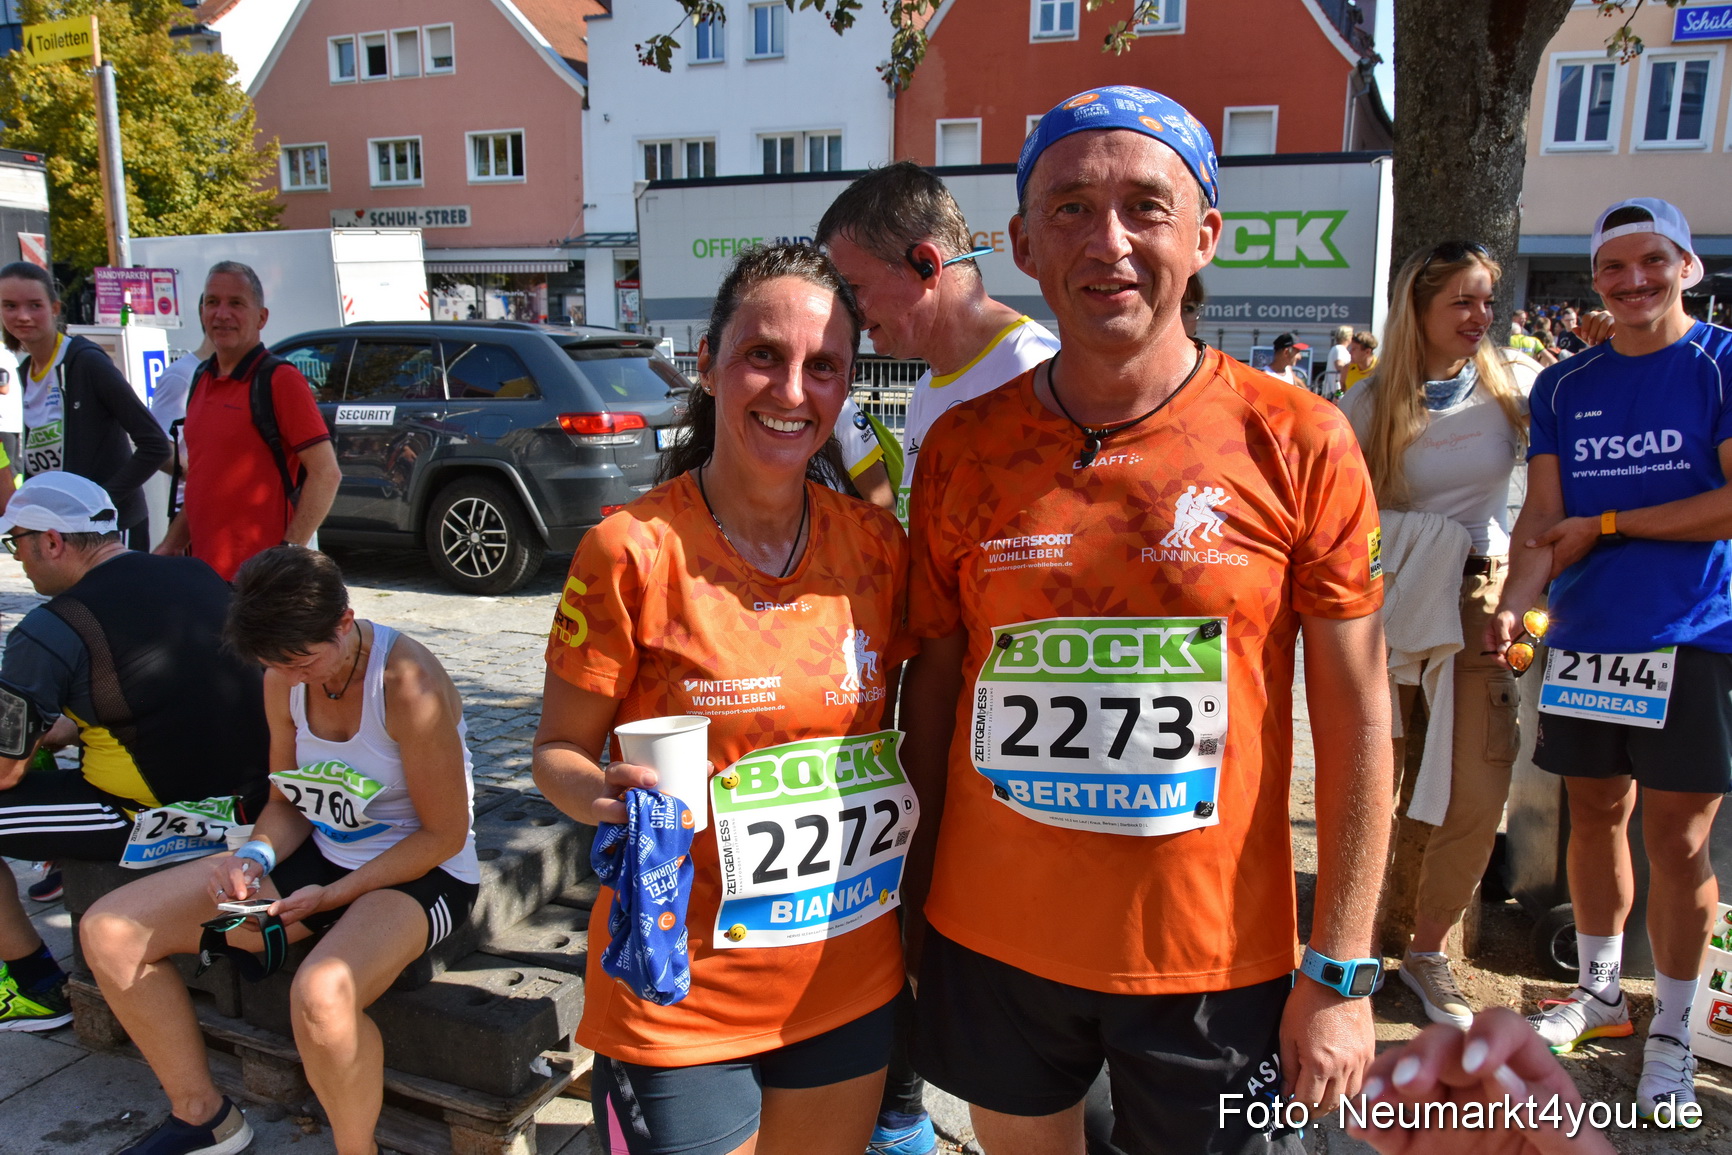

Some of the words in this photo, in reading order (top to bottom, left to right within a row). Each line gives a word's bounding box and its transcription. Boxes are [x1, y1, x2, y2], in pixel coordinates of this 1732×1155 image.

[36, 31, 89, 52] Toiletten
[370, 208, 467, 227] SCHUH-STREB
[97, 271, 149, 280] HANDYPARKEN
[1257, 303, 1349, 321] concepts
[339, 410, 391, 420] SECURITY
[1574, 429, 1682, 462] SYSCAD
[993, 533, 1074, 549] INTERSPORT
[989, 548, 1064, 564] WOHLLEBEN
[983, 561, 1073, 573] www.intersport-wohlleben.de
[753, 601, 798, 612] CRAFT
[996, 630, 1199, 672] BOCK
[1558, 651, 1656, 690] 2144
[699, 676, 781, 693] INTERSPORT
[692, 691, 776, 706] WOHLLEBEN
[1204, 700, 1215, 712] D
[1557, 691, 1648, 714] ANDREAS
[686, 704, 785, 716] www.intersport-wohlleben.de
[1001, 695, 1194, 760] 2273
[733, 743, 890, 800] BOCK
[1008, 780, 1187, 810] BERTRAM
[284, 784, 359, 828] 2760
[904, 799, 912, 810] D
[747, 799, 900, 884] 2272
[770, 877, 873, 923] BIANKA
[1596, 975, 1615, 983] CRY
